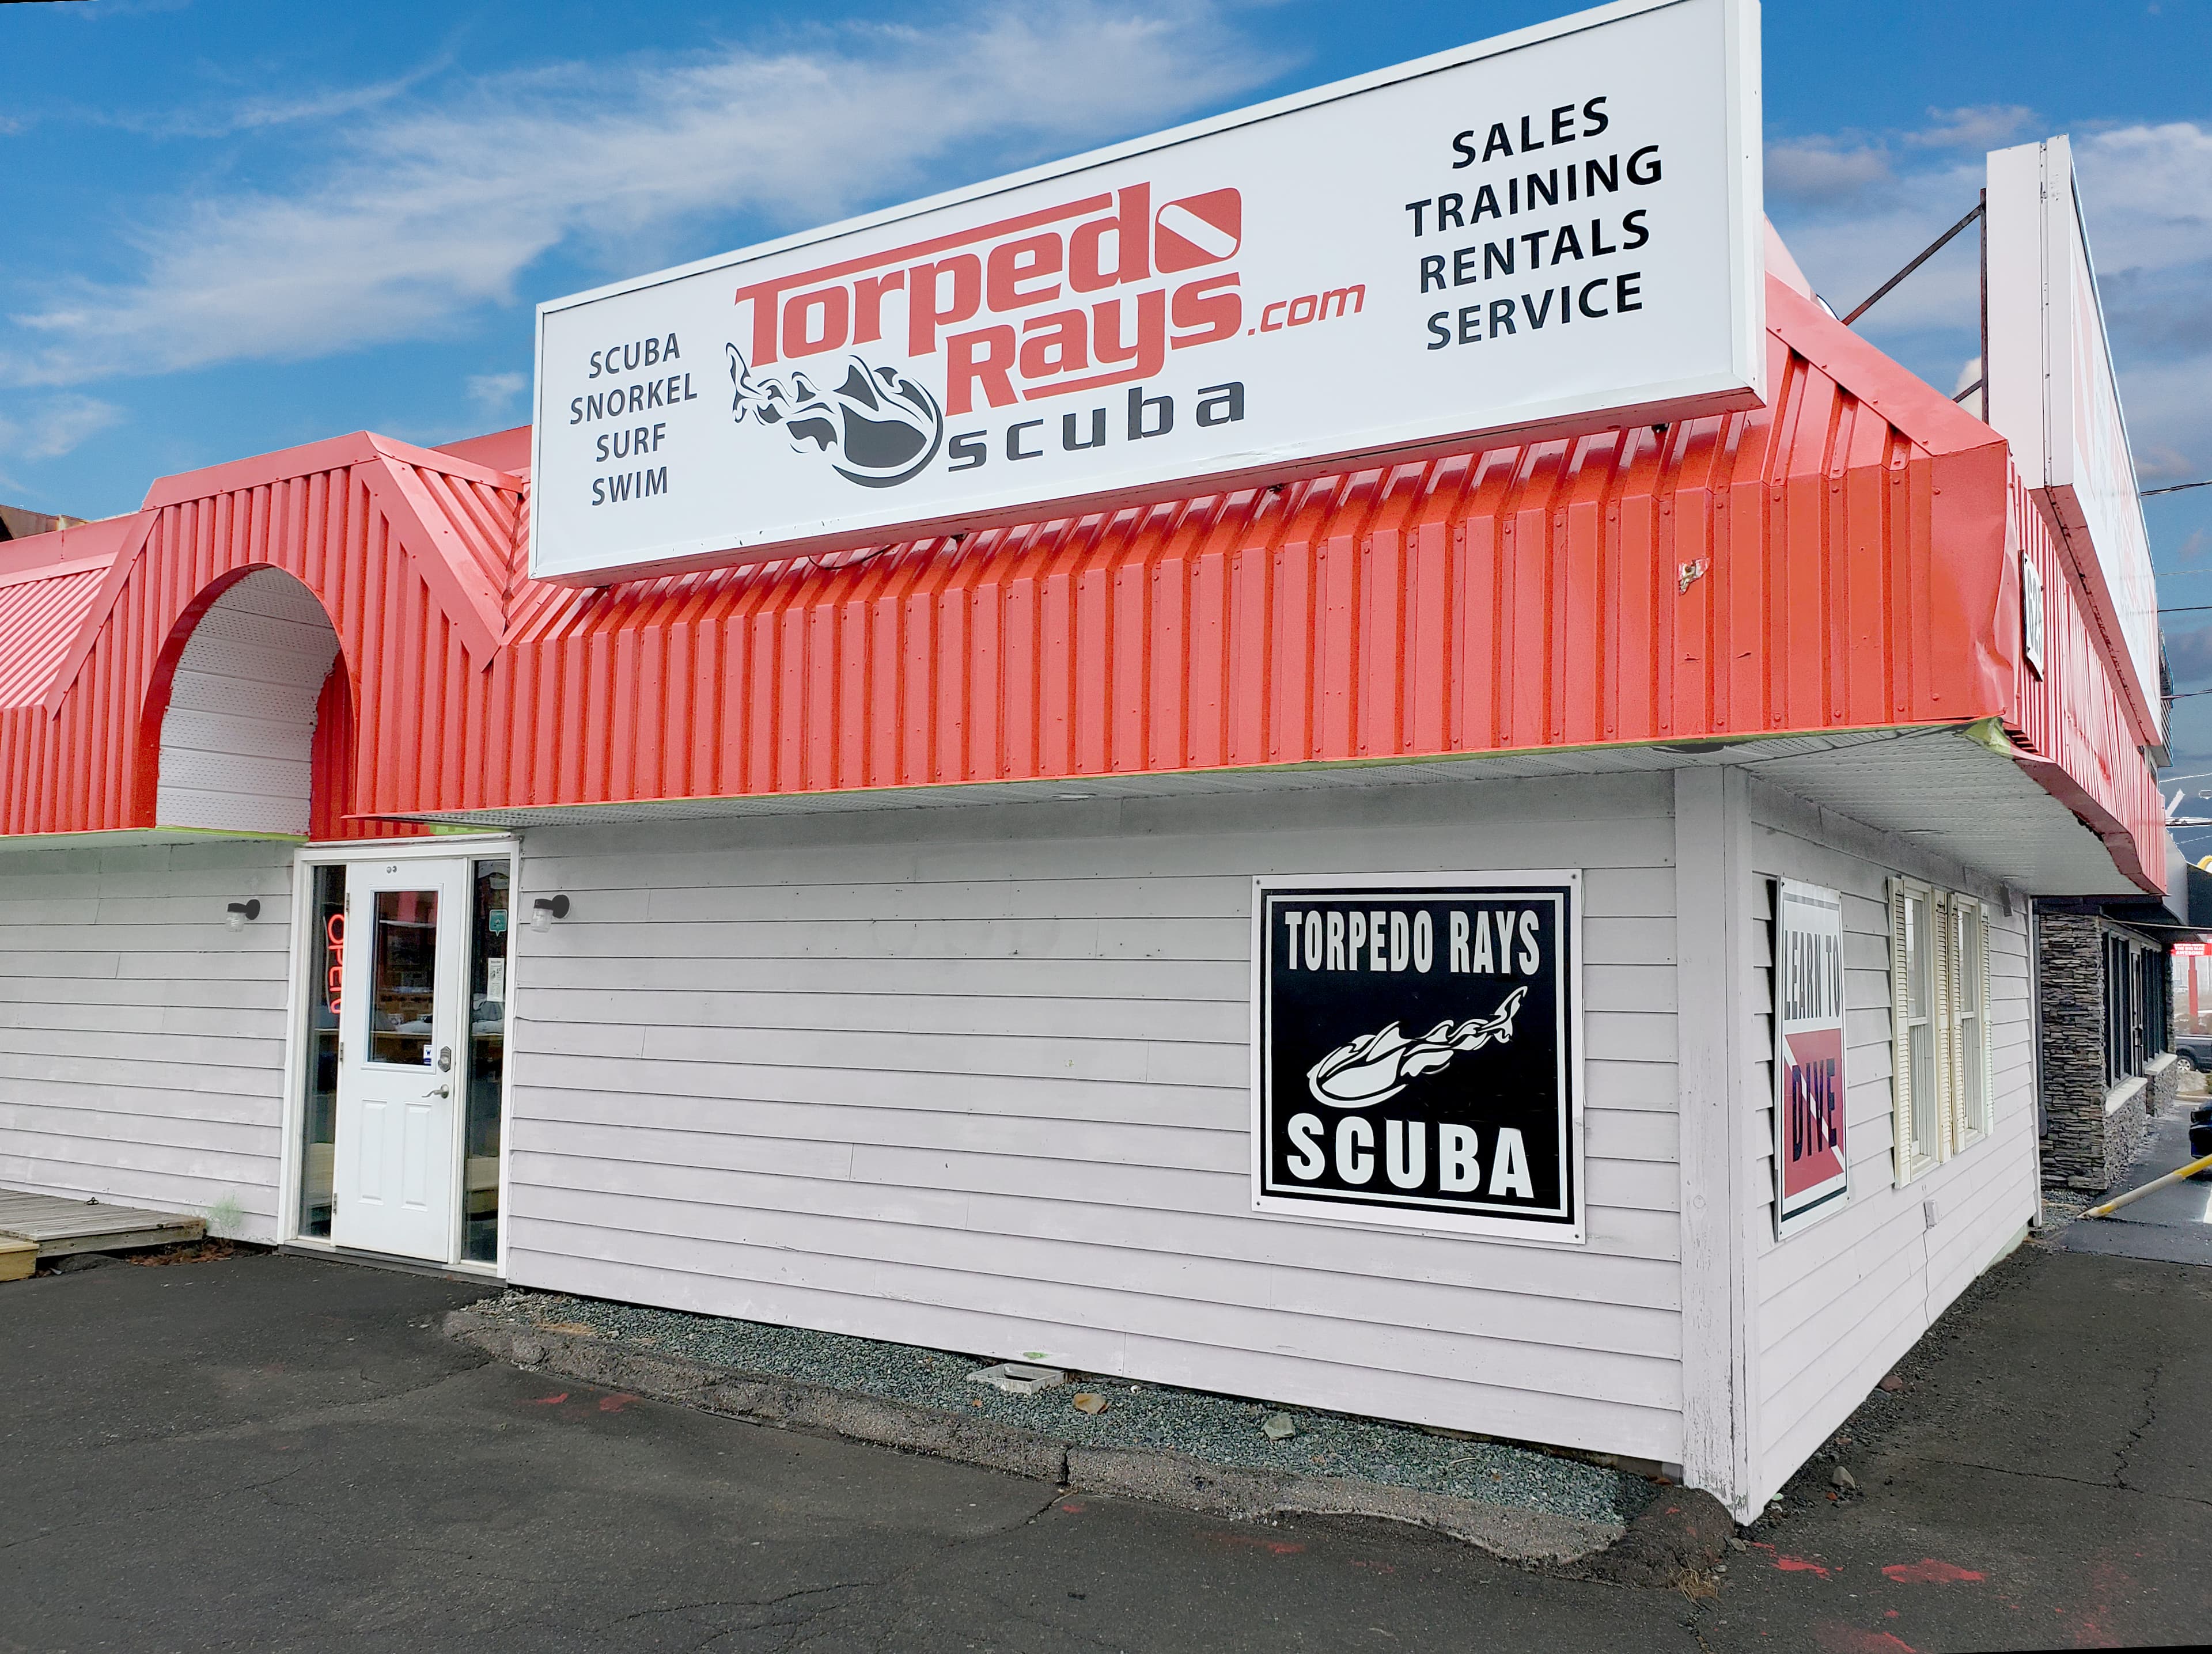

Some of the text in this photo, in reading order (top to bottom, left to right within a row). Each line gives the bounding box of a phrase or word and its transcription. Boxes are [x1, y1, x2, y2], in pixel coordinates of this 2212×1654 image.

[1452, 96, 1609, 169] SALES
[1405, 145, 1662, 238] TRAINING
[734, 181, 1242, 369] Torpedo
[1420, 208, 1650, 294] RENTALS
[945, 271, 1366, 417] Rays .com
[1426, 271, 1642, 351] SERVICE
[570, 372, 698, 425] SNORKEL
[588, 332, 681, 379] SCUBA
[596, 423, 666, 462] SURF
[948, 381, 1244, 472] scuba
[591, 466, 668, 506] SWIM
[2027, 567, 2043, 663] 625
[1285, 909, 1540, 976] TORPEDO RAYS
[1784, 929, 1840, 1021] LEARN TO
[1793, 1058, 1838, 1162] DIVE
[1286, 1113, 1536, 1199] SCUBA
